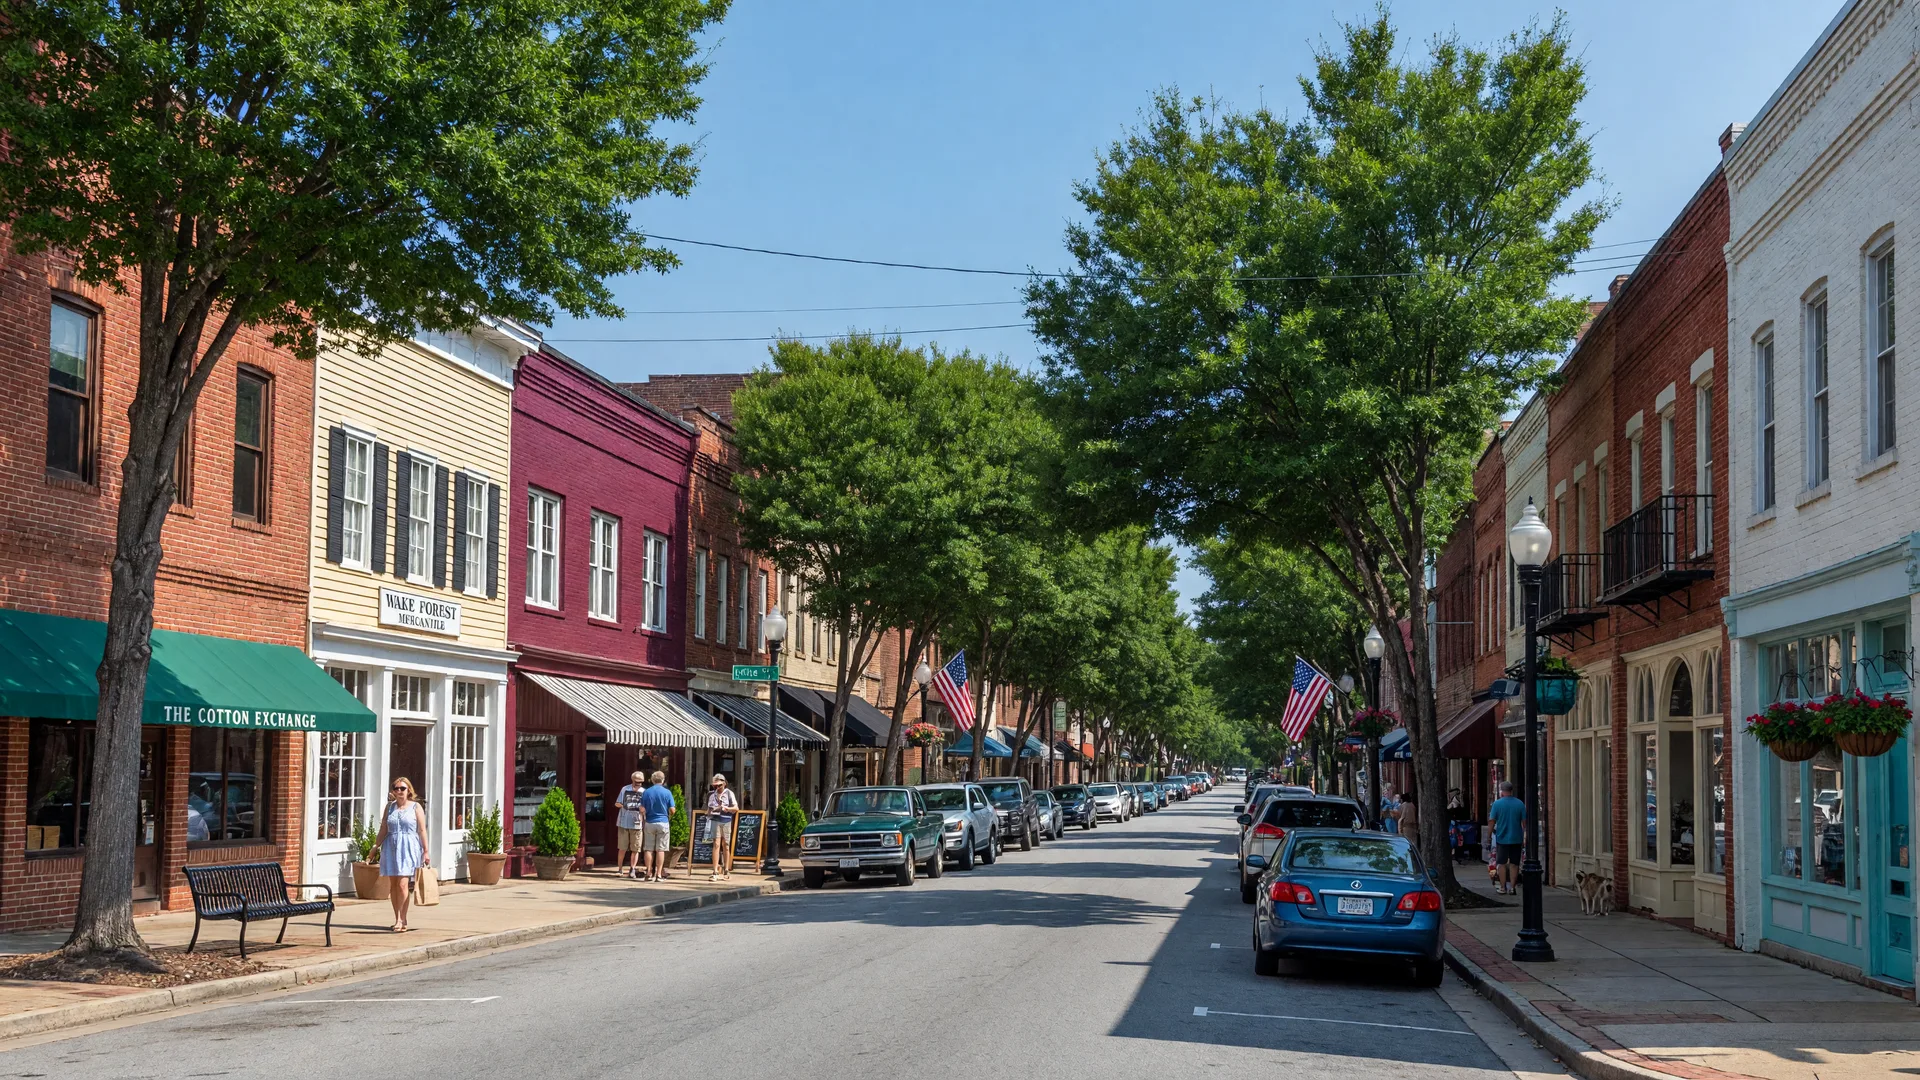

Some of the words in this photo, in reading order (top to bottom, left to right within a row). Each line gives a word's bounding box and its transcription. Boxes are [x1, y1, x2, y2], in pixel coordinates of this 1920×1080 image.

[386, 593, 415, 613] WAKE
[419, 601, 457, 620] FOREST
[164, 706, 191, 723] THE
[198, 708, 250, 725] COTTON
[255, 711, 317, 728] EXCHANGE
